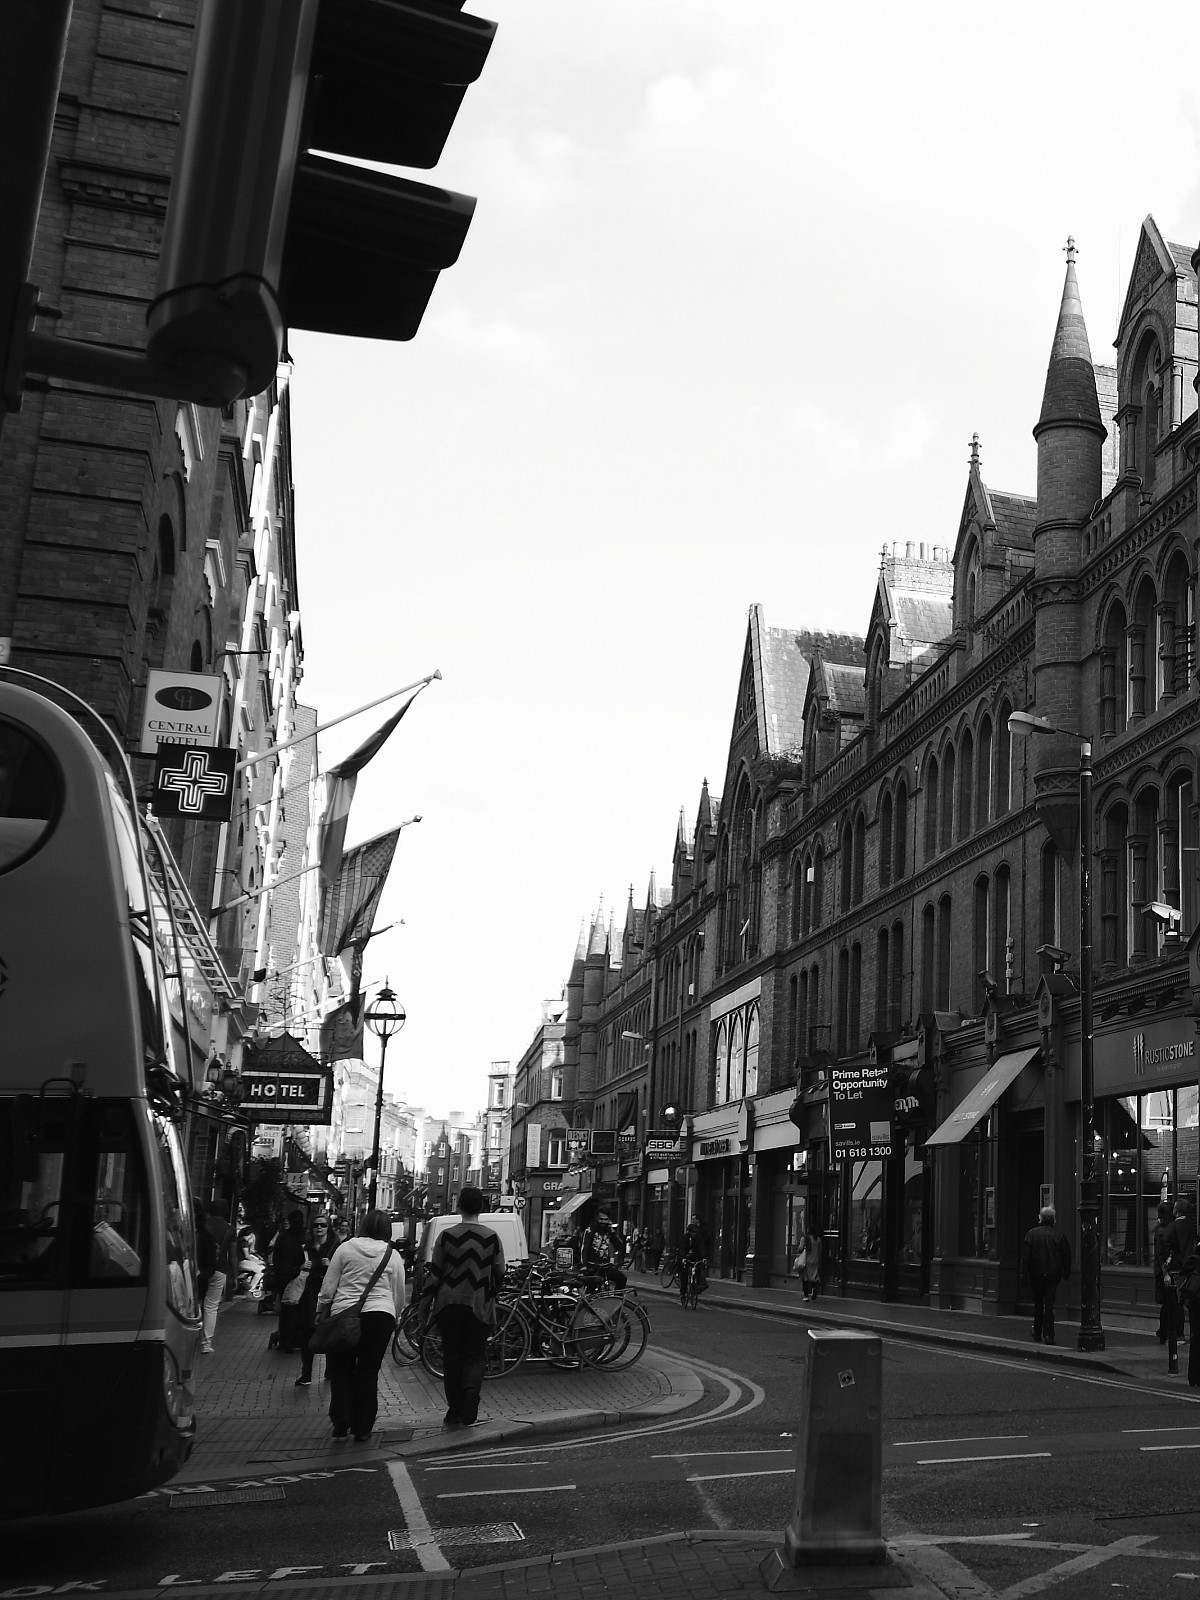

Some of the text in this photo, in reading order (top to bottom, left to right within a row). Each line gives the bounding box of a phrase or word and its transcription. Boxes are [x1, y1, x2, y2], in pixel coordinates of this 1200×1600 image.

[148, 720, 211, 734] CENTRAL
[156, 735, 198, 746] HOTEL
[832, 1069, 860, 1080] Prime
[250, 1083, 305, 1098] HOTEL
[832, 1078, 889, 1091] Opportunity
[833, 1090, 863, 1101] To Let
[648, 1140, 674, 1149] SBG
[835, 1139, 861, 1147] savills.ie
[835, 1146, 892, 1159] 01 618 1300
[157, 1561, 388, 1587] LEFT
